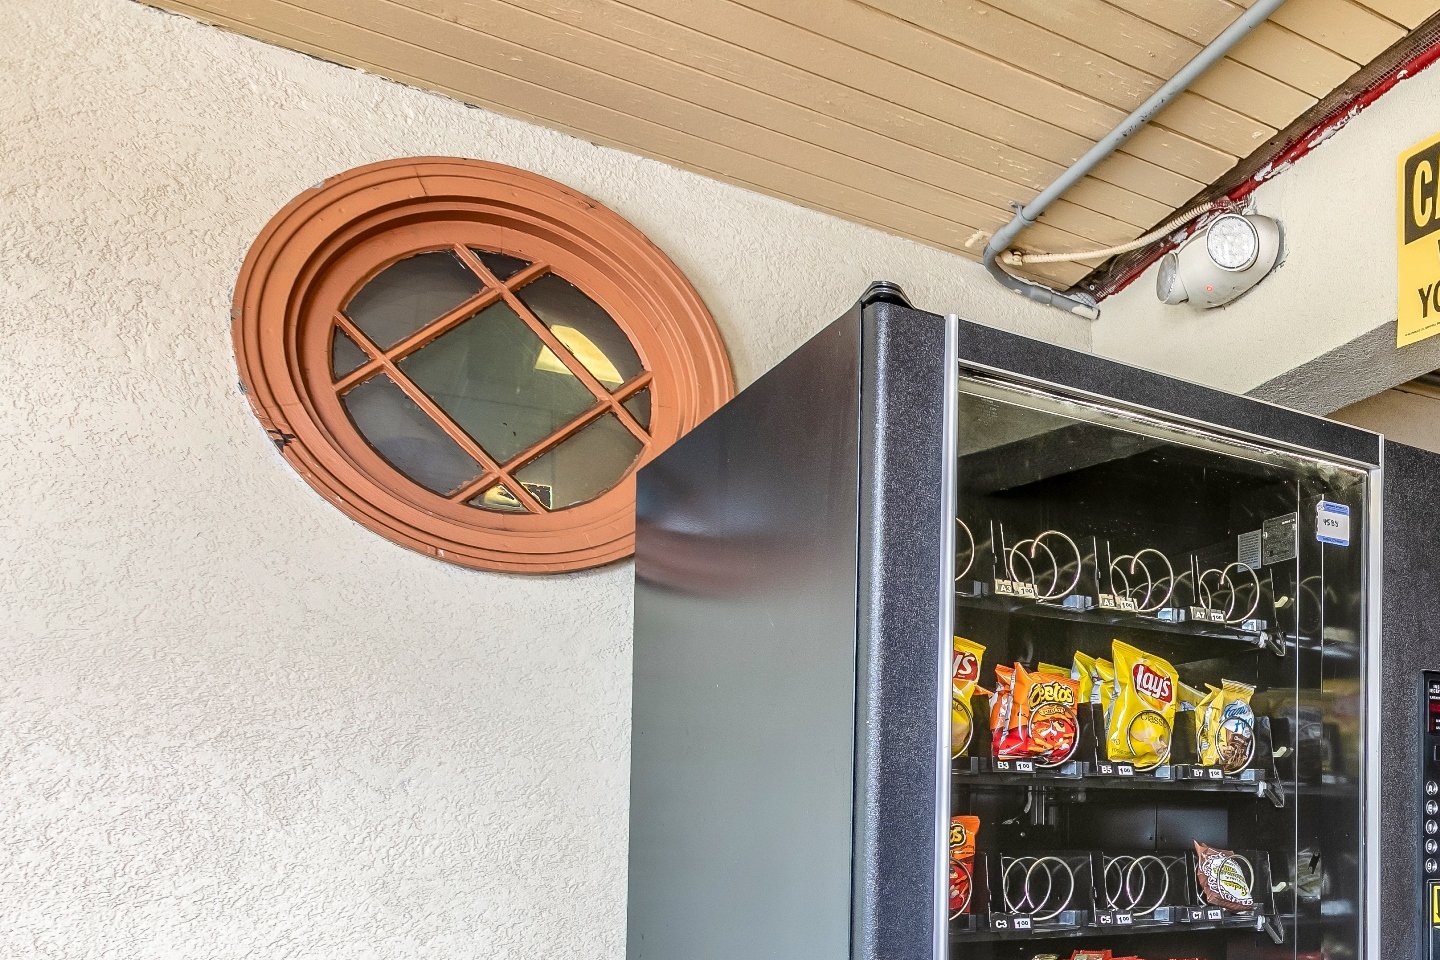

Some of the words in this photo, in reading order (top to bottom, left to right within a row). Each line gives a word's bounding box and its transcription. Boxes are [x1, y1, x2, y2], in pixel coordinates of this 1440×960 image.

[1136, 664, 1171, 699] Lay's
[995, 919, 1007, 928] C3
[1100, 915, 1111, 924] C5
